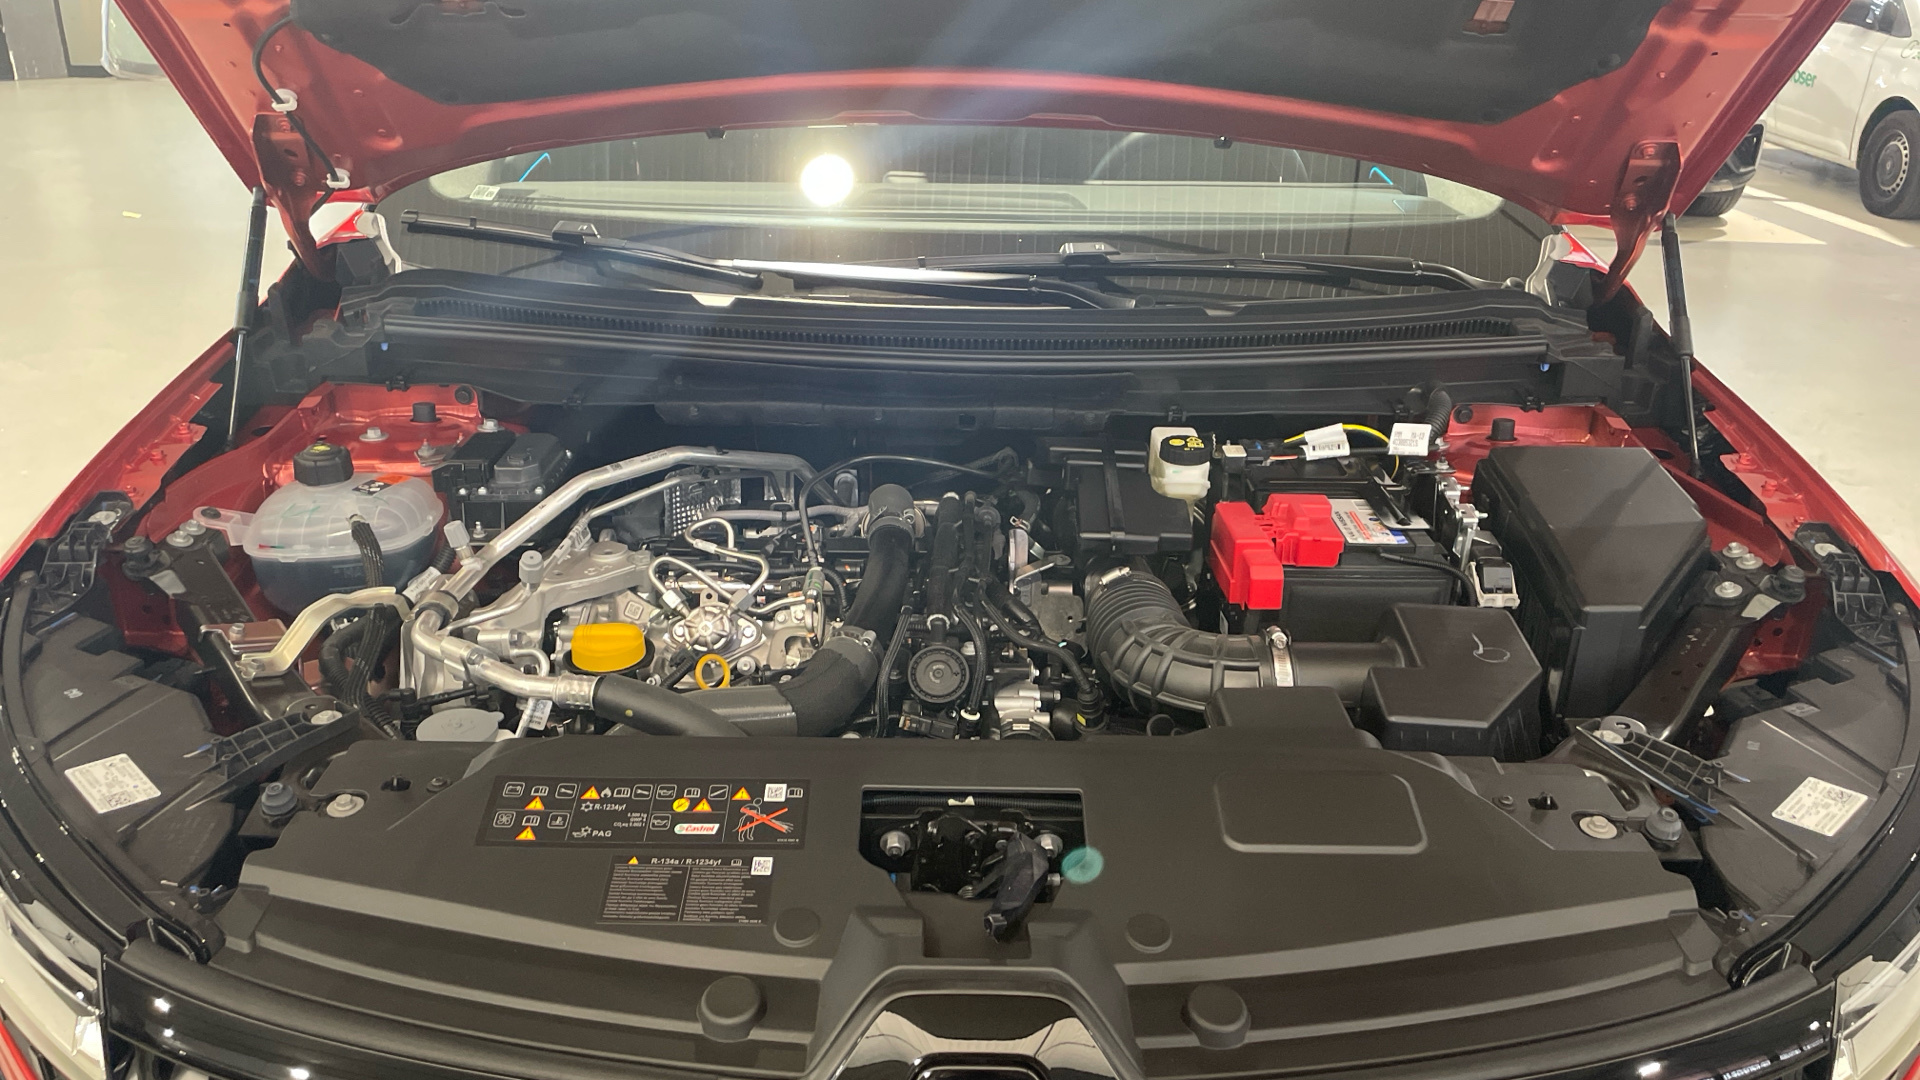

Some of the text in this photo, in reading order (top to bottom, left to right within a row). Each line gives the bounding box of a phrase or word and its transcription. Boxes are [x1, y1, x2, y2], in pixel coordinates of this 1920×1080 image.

[1793, 69, 1816, 87] oser
[594, 803, 626, 812] R-1234yf
[685, 824, 716, 833] Castrol
[650, 857, 680, 865] R-134a
[685, 858, 722, 867] R-1234yf
